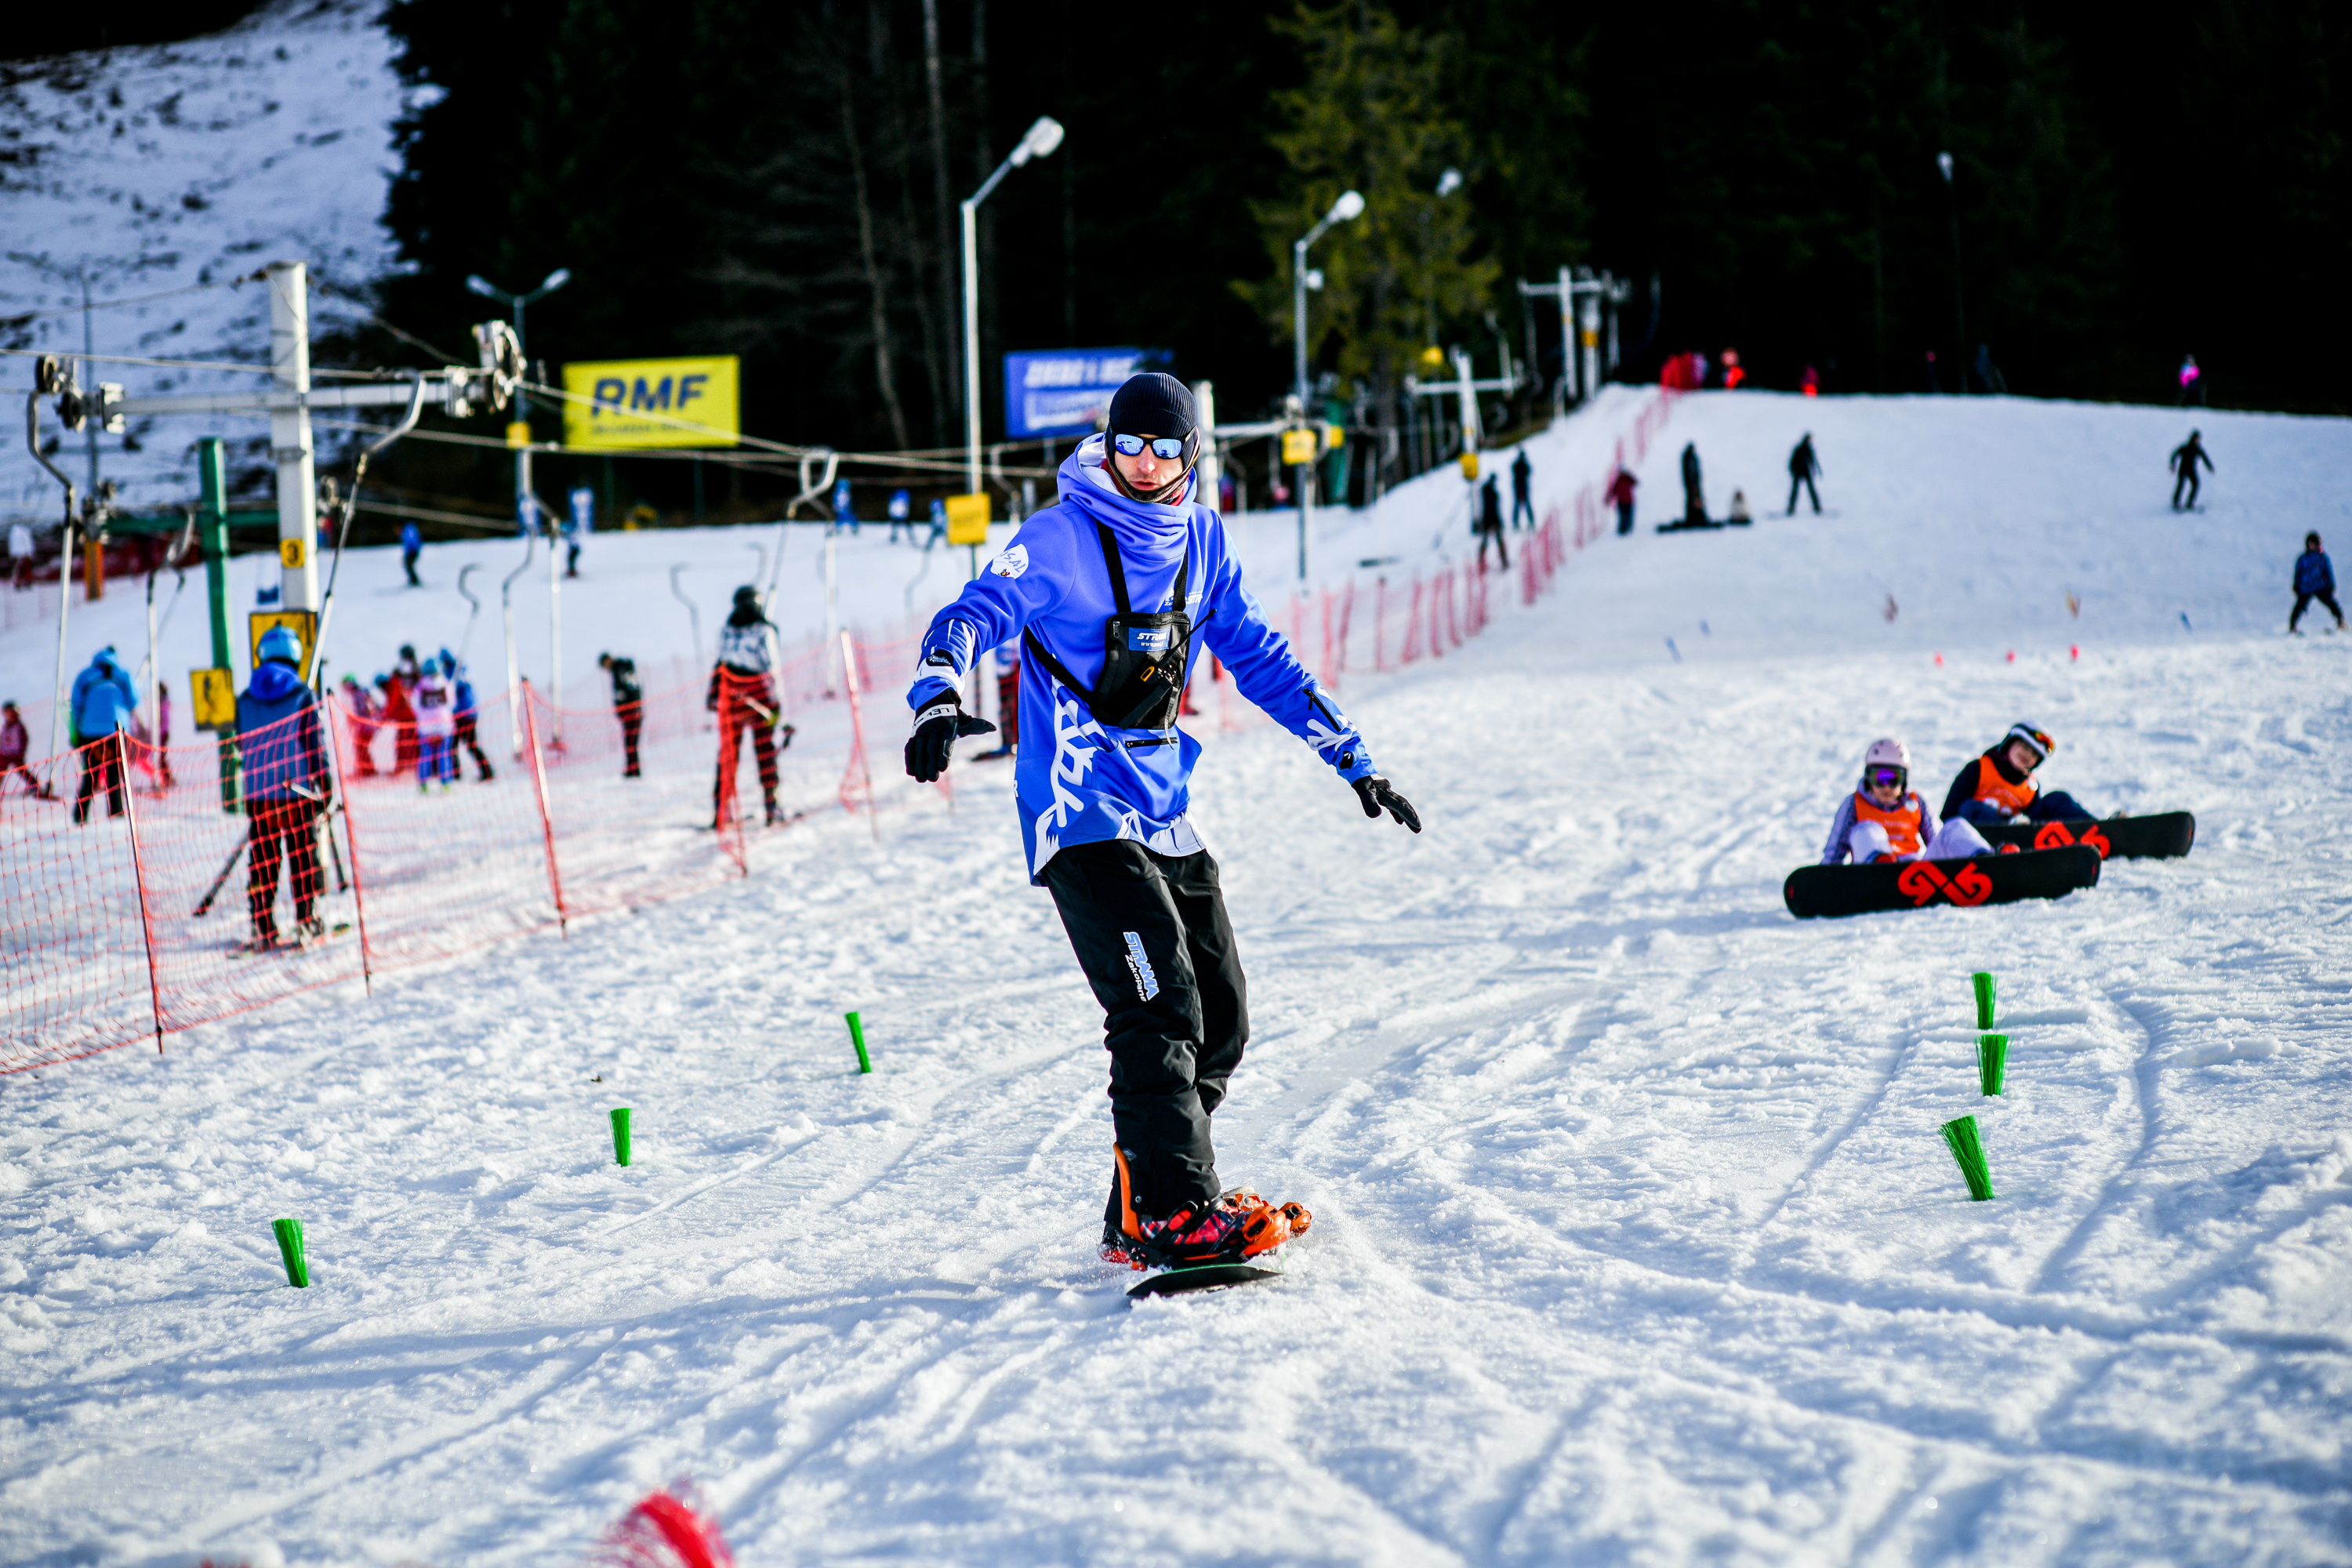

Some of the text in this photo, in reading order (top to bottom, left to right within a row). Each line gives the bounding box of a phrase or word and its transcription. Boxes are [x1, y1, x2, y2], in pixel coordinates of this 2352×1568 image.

[591, 374, 709, 416] RMF
[286, 541, 299, 564] 3
[1123, 931, 1160, 1000] STRAMA
[1125, 954, 1147, 1002] Zakopane
